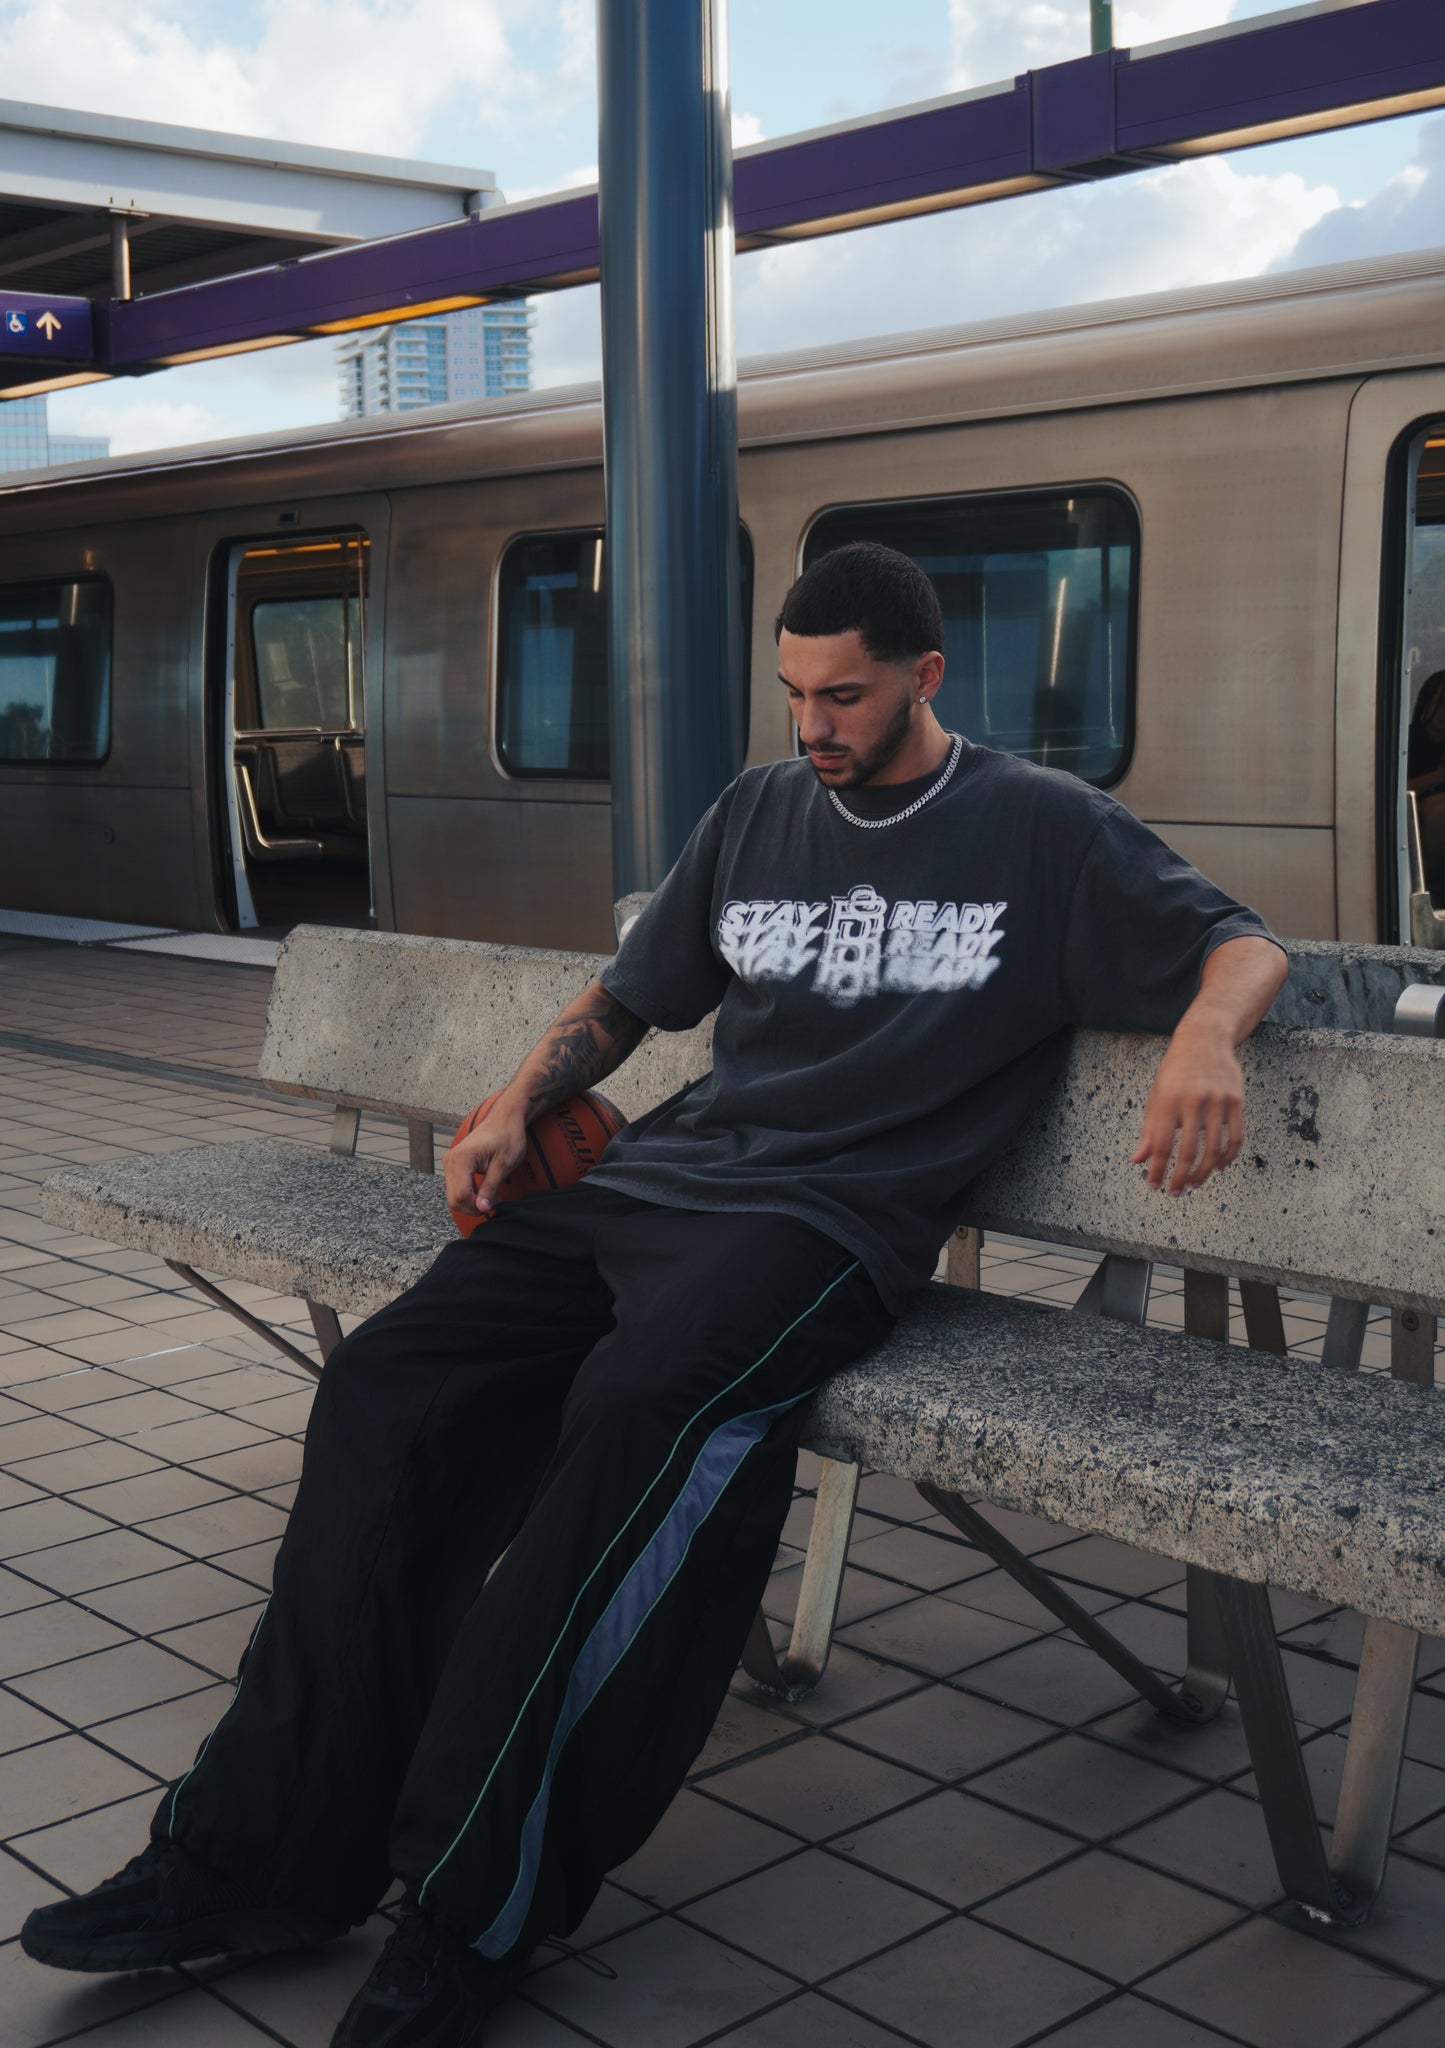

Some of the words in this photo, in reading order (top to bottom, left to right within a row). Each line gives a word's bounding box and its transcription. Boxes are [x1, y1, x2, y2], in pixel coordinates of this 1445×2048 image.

[718, 901, 829, 931] STAY
[887, 901, 1008, 933] READY
[556, 1104, 597, 1167] VOLU
